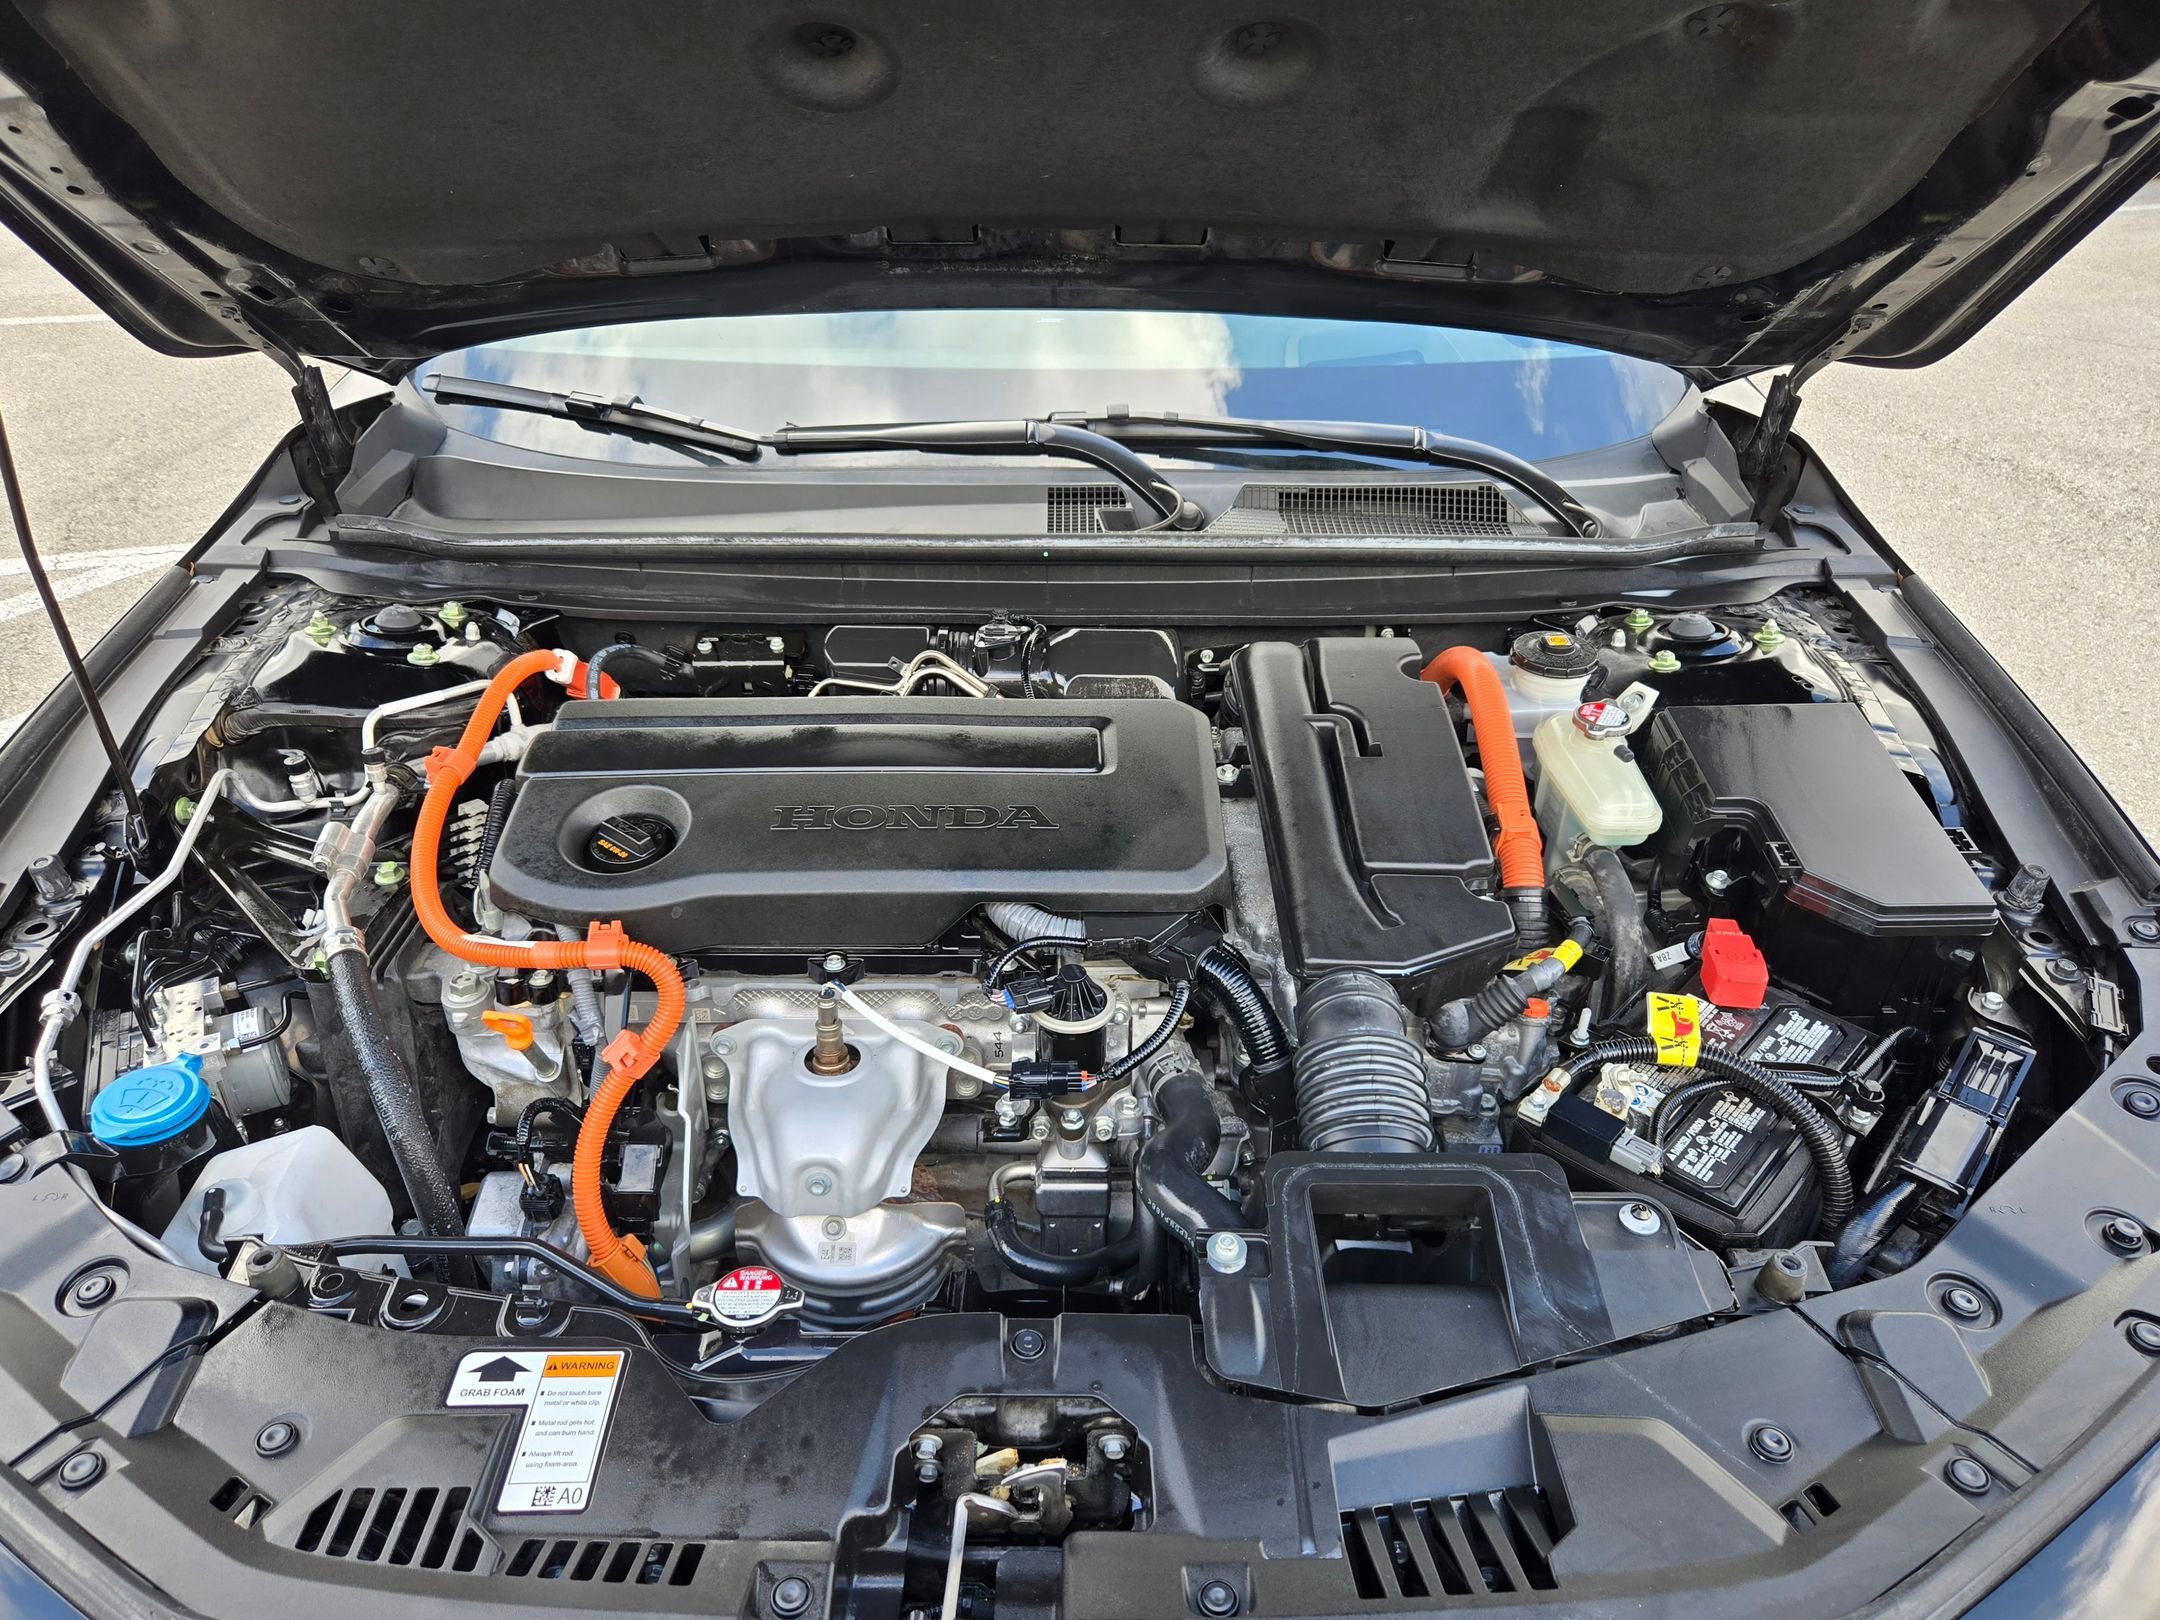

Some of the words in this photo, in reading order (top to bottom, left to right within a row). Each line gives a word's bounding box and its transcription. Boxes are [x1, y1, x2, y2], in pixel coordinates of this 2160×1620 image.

[770, 804, 1060, 830] HONDA
[993, 1031, 1004, 1059] 544
[560, 1362, 615, 1370] WARNING
[460, 1388, 491, 1397] GRAB
[493, 1388, 525, 1396] FOAM
[556, 1487, 583, 1504] A0
